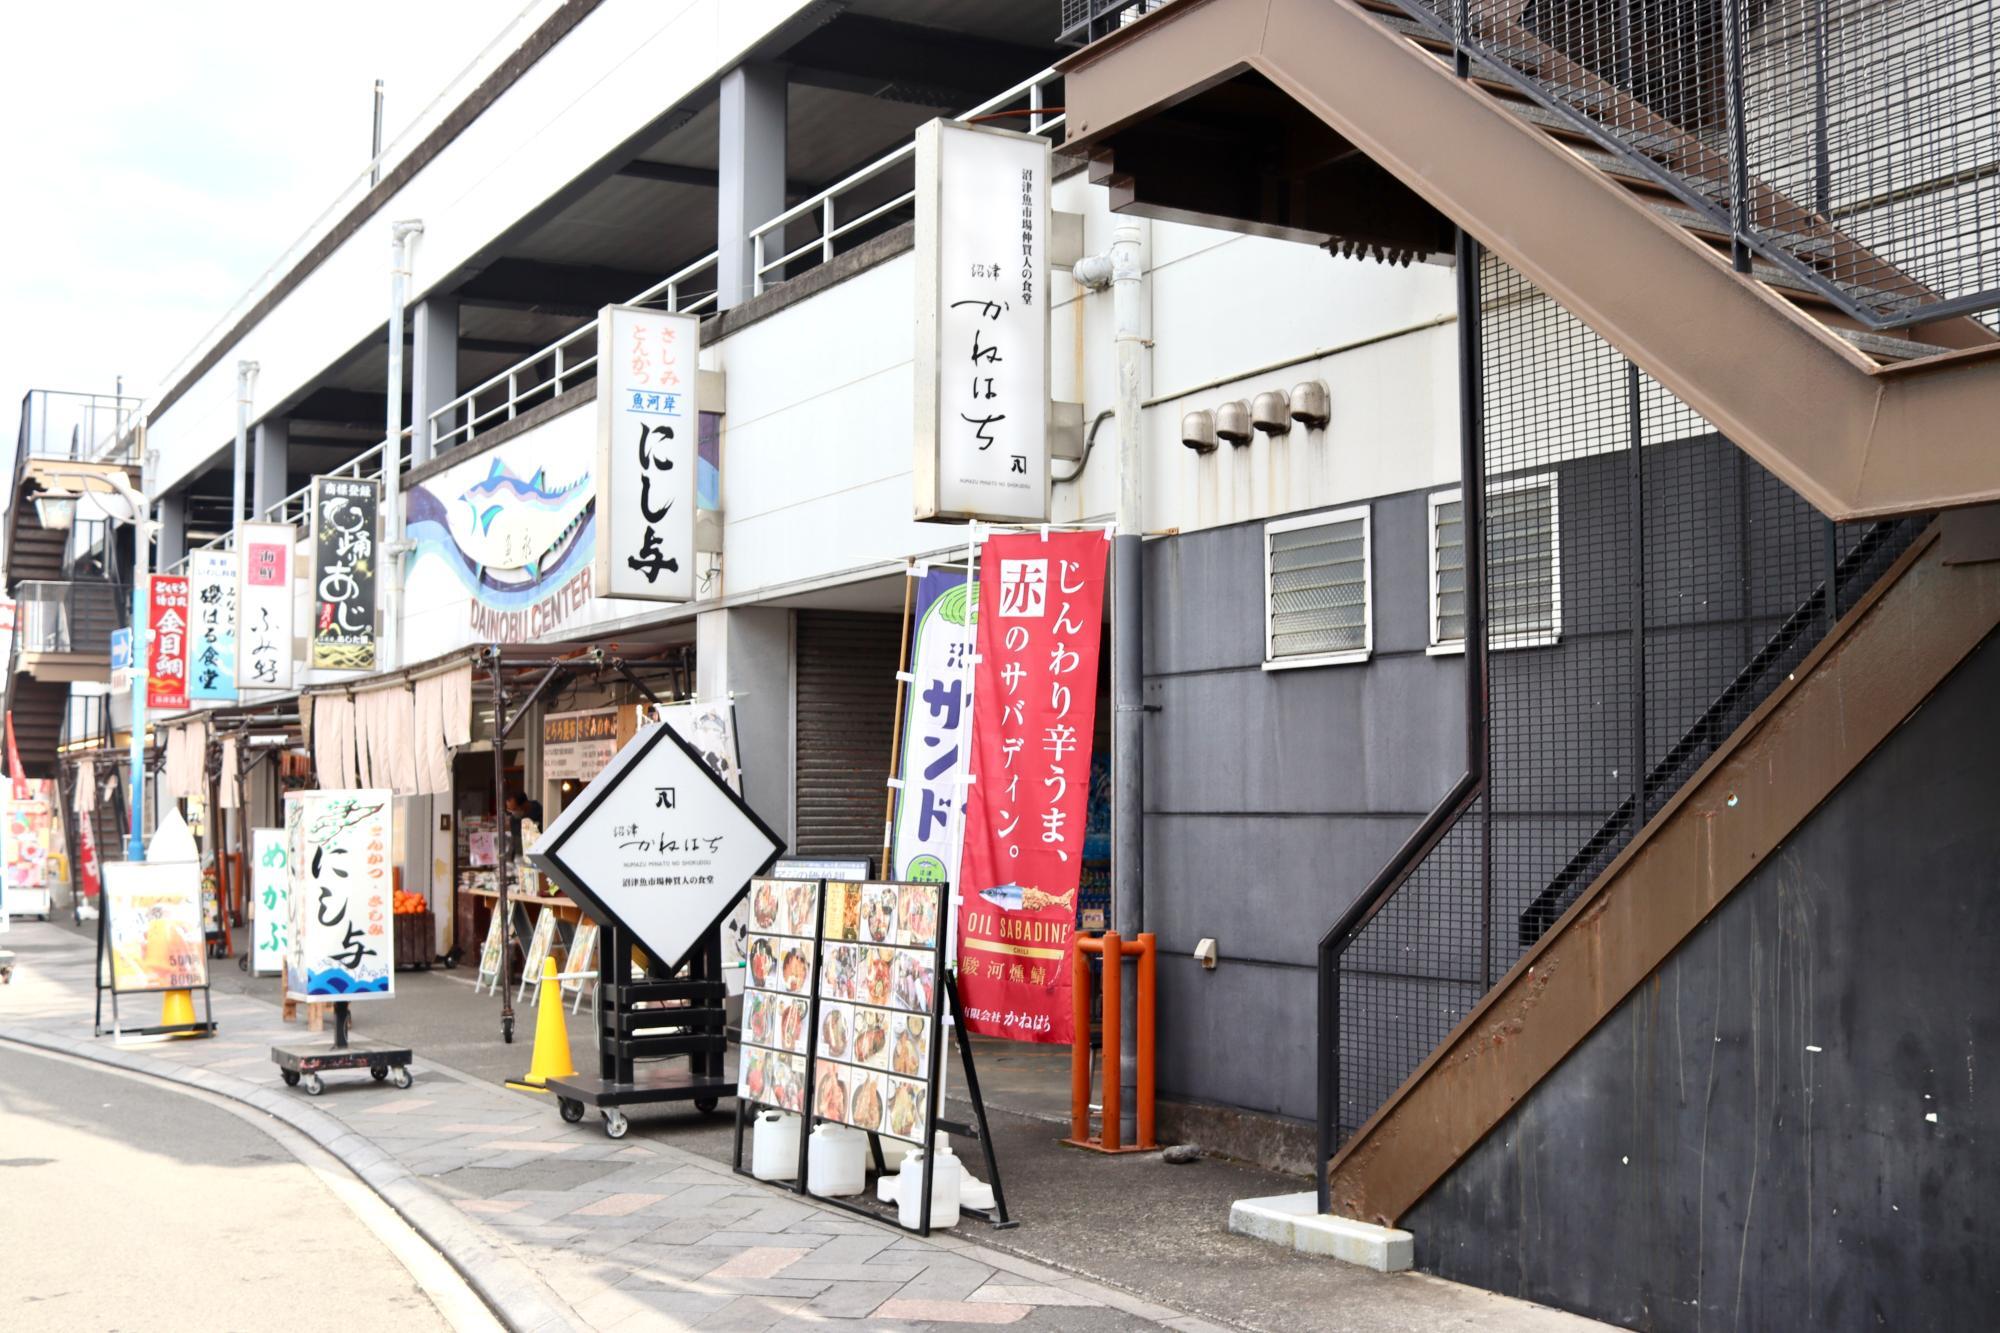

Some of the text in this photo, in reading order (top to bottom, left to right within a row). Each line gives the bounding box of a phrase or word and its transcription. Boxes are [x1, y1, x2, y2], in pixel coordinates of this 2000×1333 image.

[1021, 169, 1033, 305] 沼津魚市場仲買人の食堂
[971, 263, 1001, 282] 沼津
[632, 325, 651, 385] とんかつ
[659, 327, 680, 387] さしみ
[951, 299, 1009, 450] かねはち
[631, 392, 676, 413] 魚河岸
[628, 422, 679, 583] にし与
[469, 567, 593, 645] DAINOBU CENTER
[156, 607, 186, 679] 金目鯛
[998, 558, 1048, 859] 赤のサバディン。
[1041, 559, 1084, 862] じんわり辛うま、
[613, 823, 639, 838] 沼津
[619, 832, 723, 855] かねはち
[259, 842, 287, 952] めかぶ
[311, 845, 377, 969] にし与
[622, 874, 714, 888] 沼津魚市場仲買人の食堂
[967, 912, 992, 936] OIL
[1013, 946, 1029, 955] CHILI
[1003, 1010, 1051, 1033] かねはち
